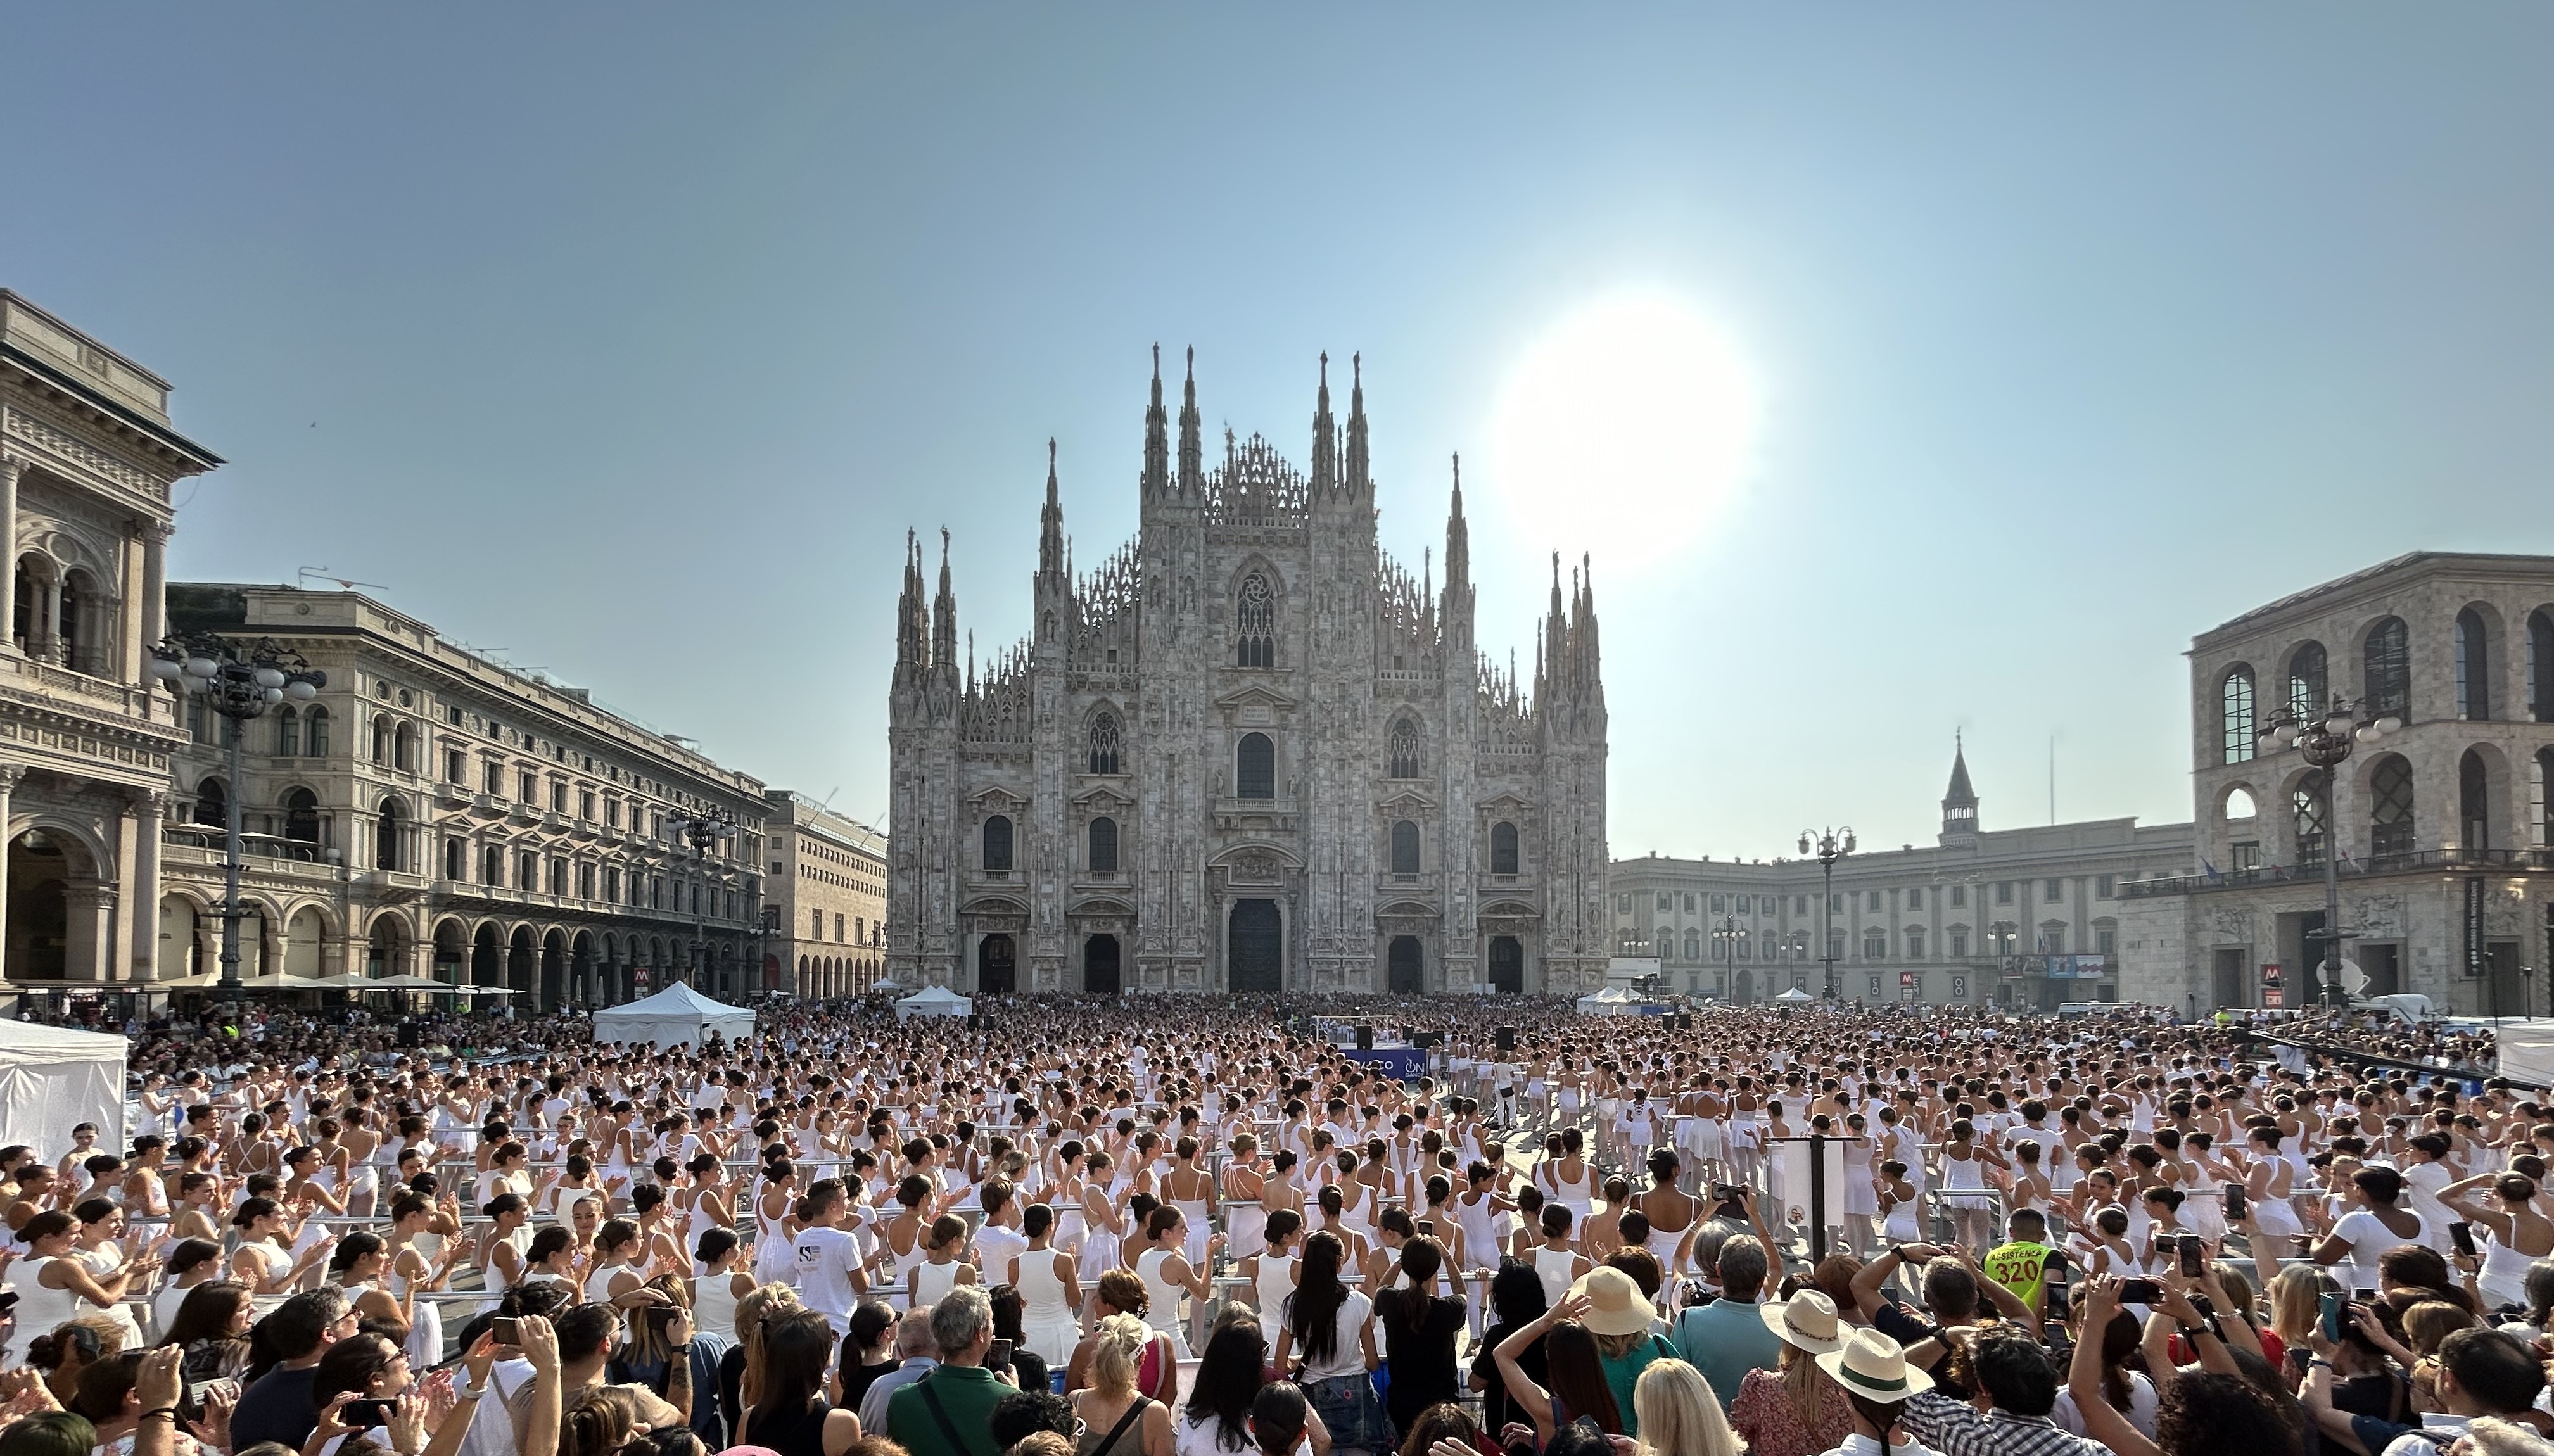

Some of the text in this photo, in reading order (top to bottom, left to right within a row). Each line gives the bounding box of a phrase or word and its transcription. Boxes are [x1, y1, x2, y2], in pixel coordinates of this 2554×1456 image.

[635, 971, 648, 980] M
[1902, 974, 1912, 982] M
[1990, 1250, 2042, 1262] ASSISTENZA
[1996, 1260, 2039, 1284] 320
